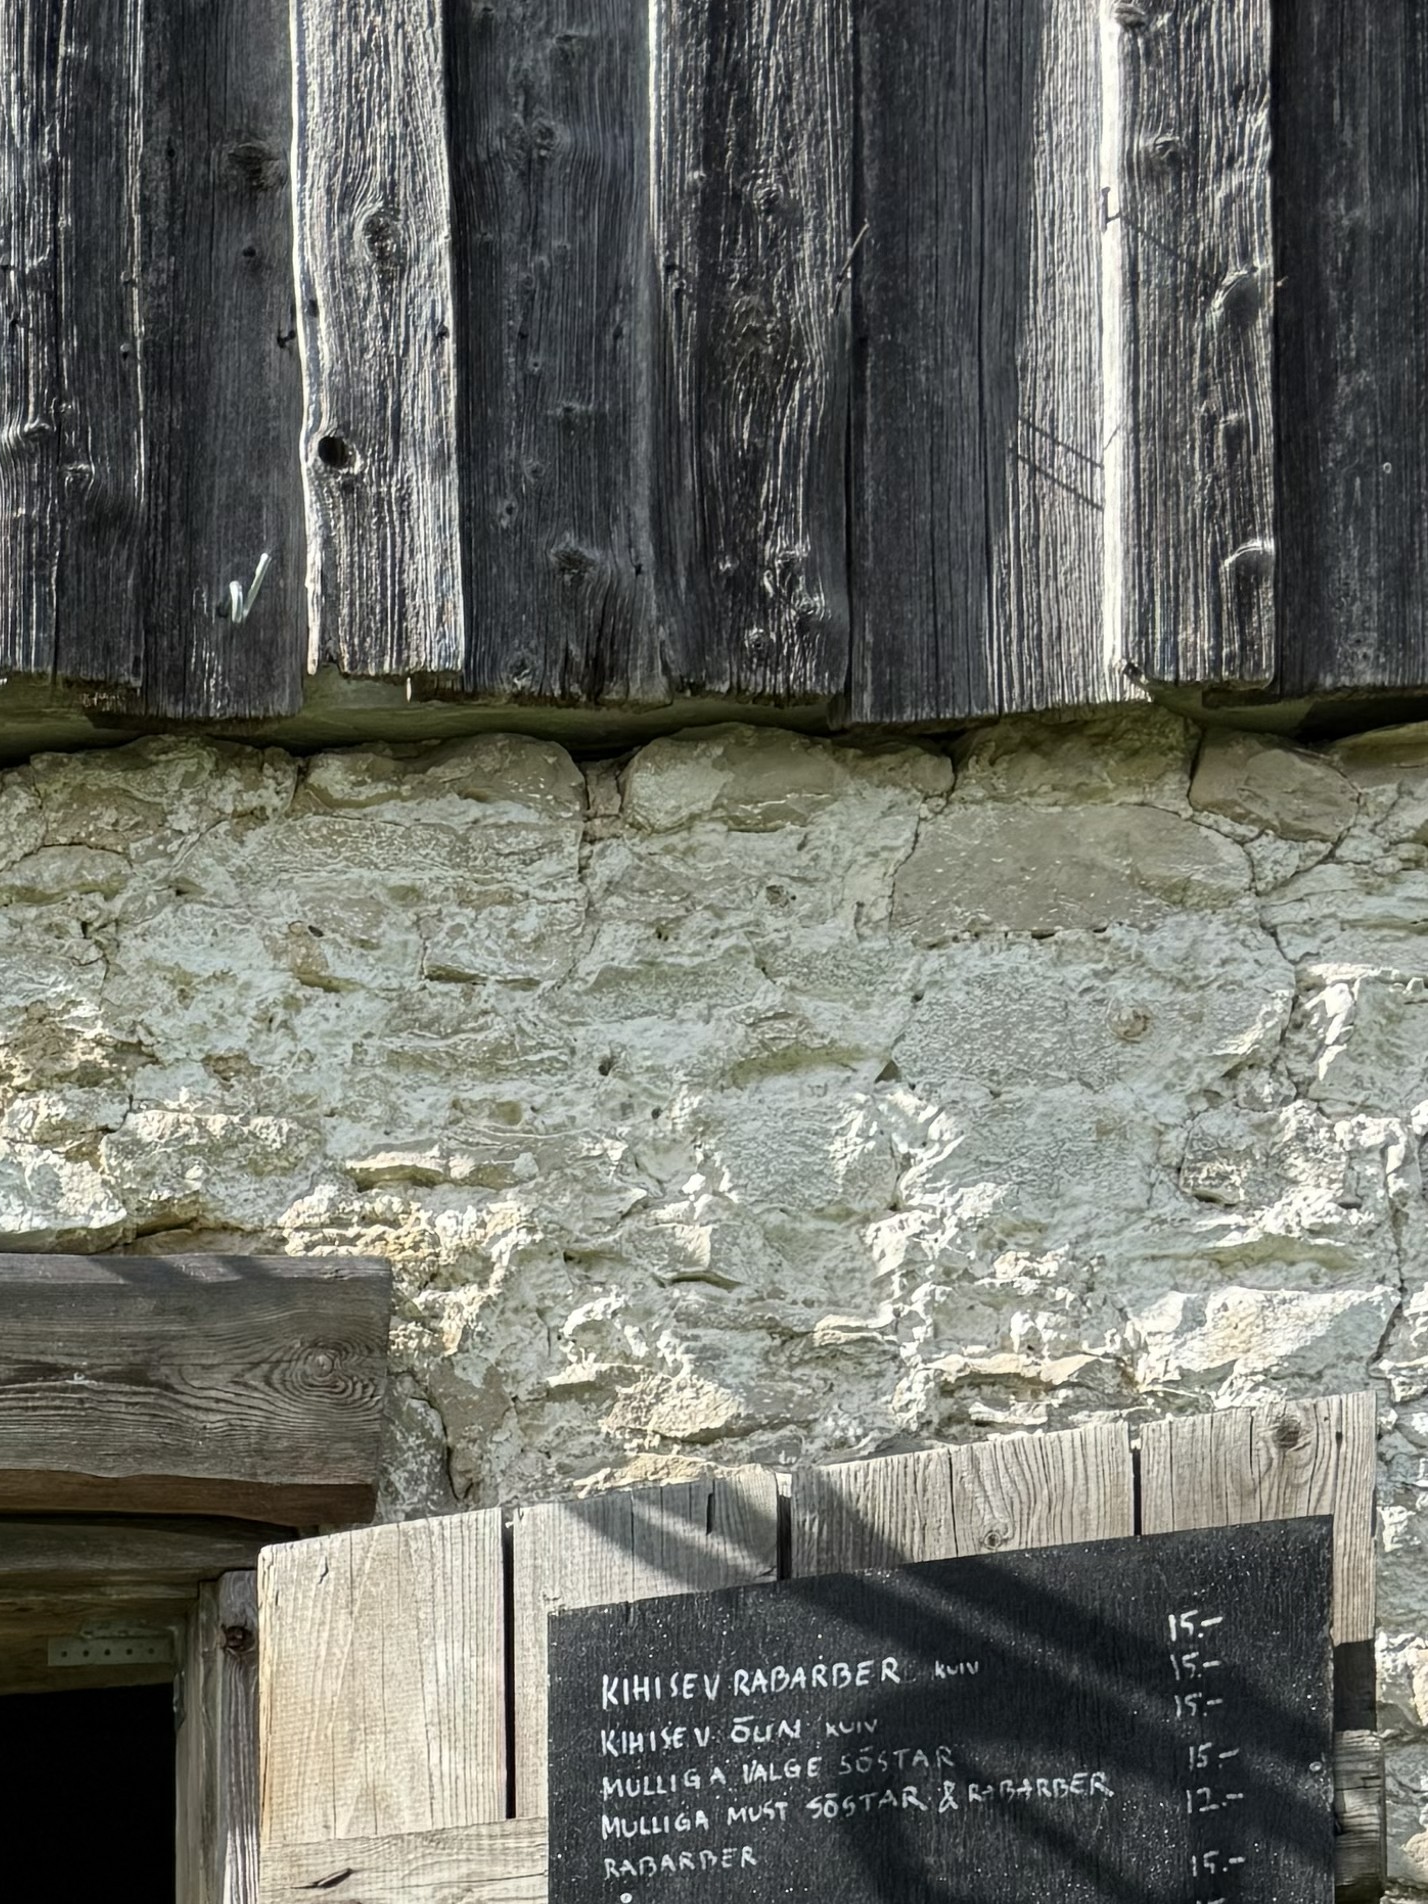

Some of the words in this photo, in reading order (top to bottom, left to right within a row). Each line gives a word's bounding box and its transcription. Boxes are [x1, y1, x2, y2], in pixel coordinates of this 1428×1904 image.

[1169, 1609, 1224, 1642] 15.-
[1170, 1651, 1222, 1681] 15.-
[602, 1672, 721, 1710] KIHISEV
[733, 1656, 900, 1697] RABARBER
[935, 1660, 979, 1679] KUIV
[1174, 1692, 1224, 1718] 15.-
[601, 1726, 710, 1758] KIHISEV
[826, 1719, 878, 1738] KUIV
[1189, 1742, 1240, 1771] 15.-
[601, 1767, 727, 1801] MULLIGA
[743, 1757, 822, 1784] VALGE
[838, 1746, 954, 1775] SÕSTAR
[601, 1810, 710, 1841] MULLIGA
[727, 1800, 789, 1826] MUST
[805, 1786, 928, 1819] SÕSTAR
[938, 1780, 958, 1813] &
[604, 1846, 757, 1879] RABARBER
[1192, 1850, 1245, 1877] 15.-
